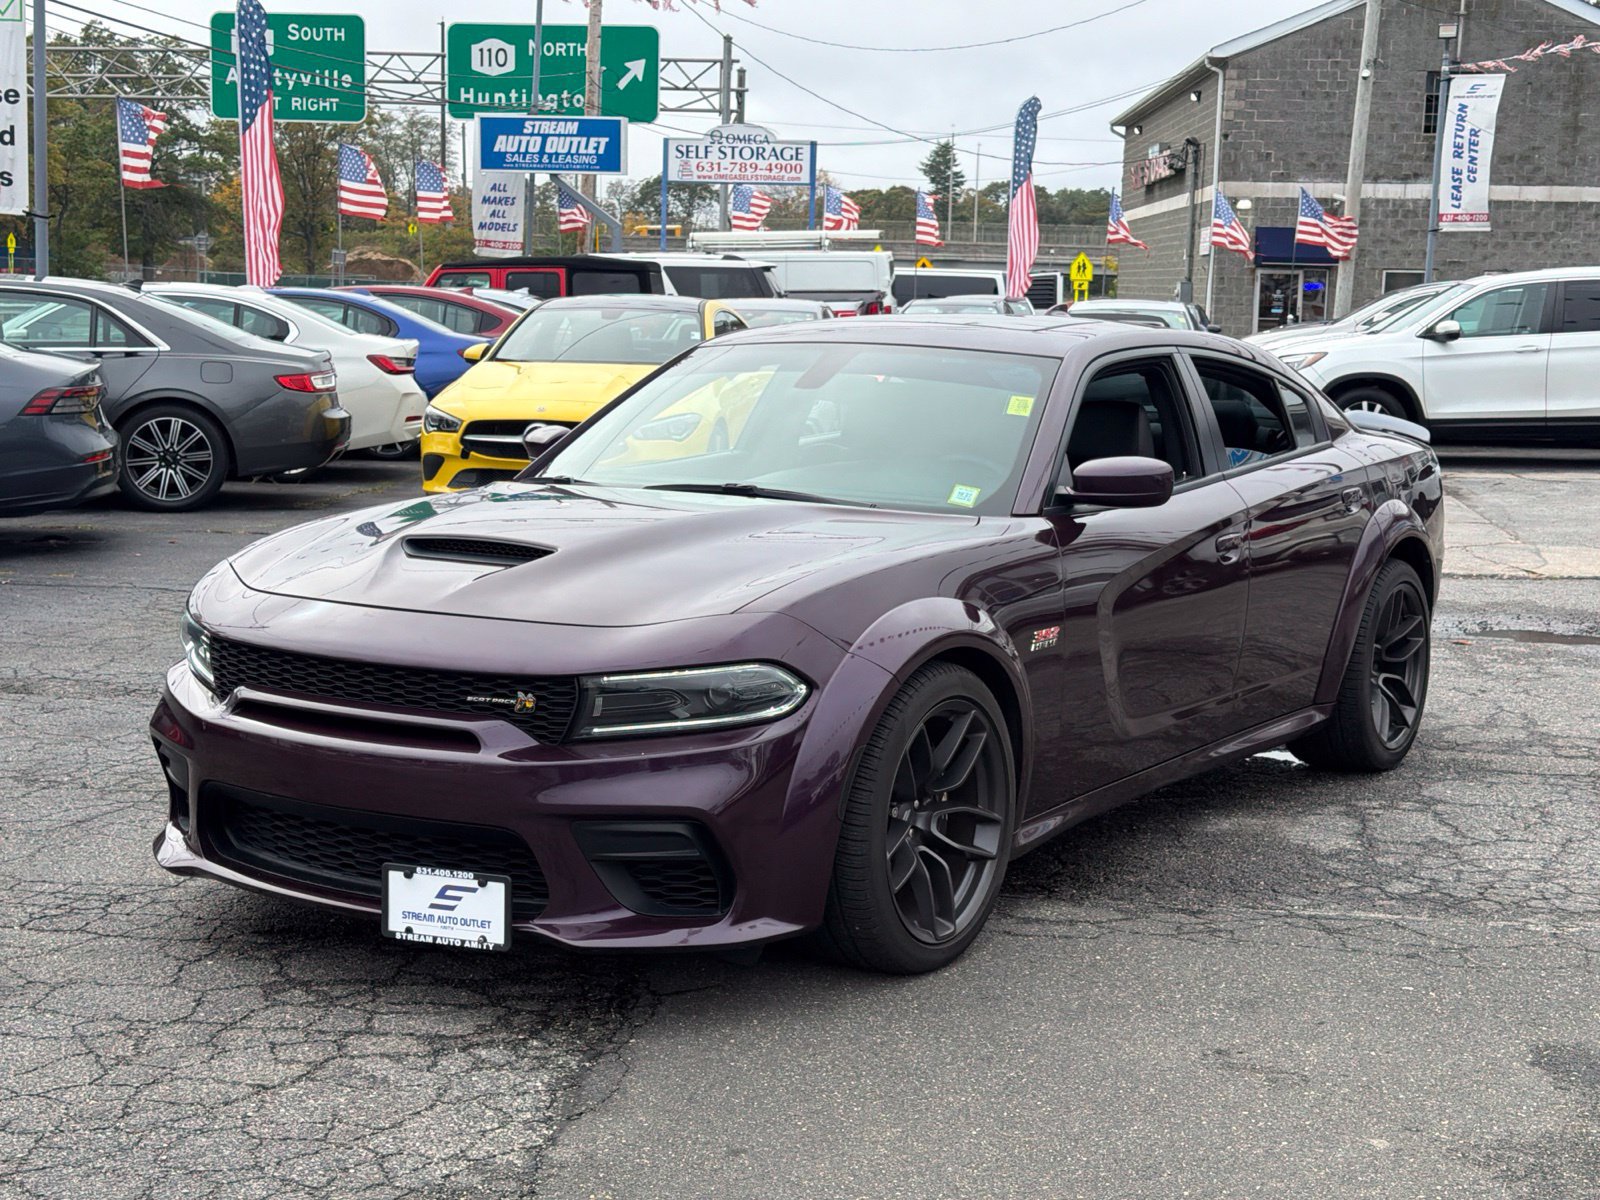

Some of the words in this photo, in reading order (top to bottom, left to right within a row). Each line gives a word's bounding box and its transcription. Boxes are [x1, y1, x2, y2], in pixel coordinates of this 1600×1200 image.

[287, 23, 345, 41] SOUTH
[479, 47, 508, 68] 110
[225, 67, 353, 91] Atyville
[291, 97, 340, 112] RIGHT
[460, 87, 585, 113] Huntigto
[523, 121, 579, 135] STREAM
[1452, 103, 1469, 160] RETURN
[493, 135, 542, 153] AUTO
[545, 136, 610, 155] OUTLET
[726, 133, 770, 145] OMEGA
[505, 153, 539, 163] SALES
[542, 154, 549, 163] &
[551, 154, 598, 165] LEASING
[675, 144, 713, 160] SELF
[717, 145, 804, 162] STORAGE
[1466, 128, 1482, 183] CENTER
[695, 161, 803, 175] 631-789-4900
[490, 183, 508, 193] ALL
[1451, 166, 1463, 210] LEASE
[481, 195, 516, 207] MAKES
[489, 209, 507, 219] ALL
[478, 221, 518, 233] MODELS
[416, 866, 474, 880] 631.400.1200
[402, 910, 435, 923] STREAM
[437, 914, 458, 926] AUTO
[460, 917, 492, 930] OUTLET
[395, 931, 433, 944] STREAM
[435, 937, 461, 947] AUTO
